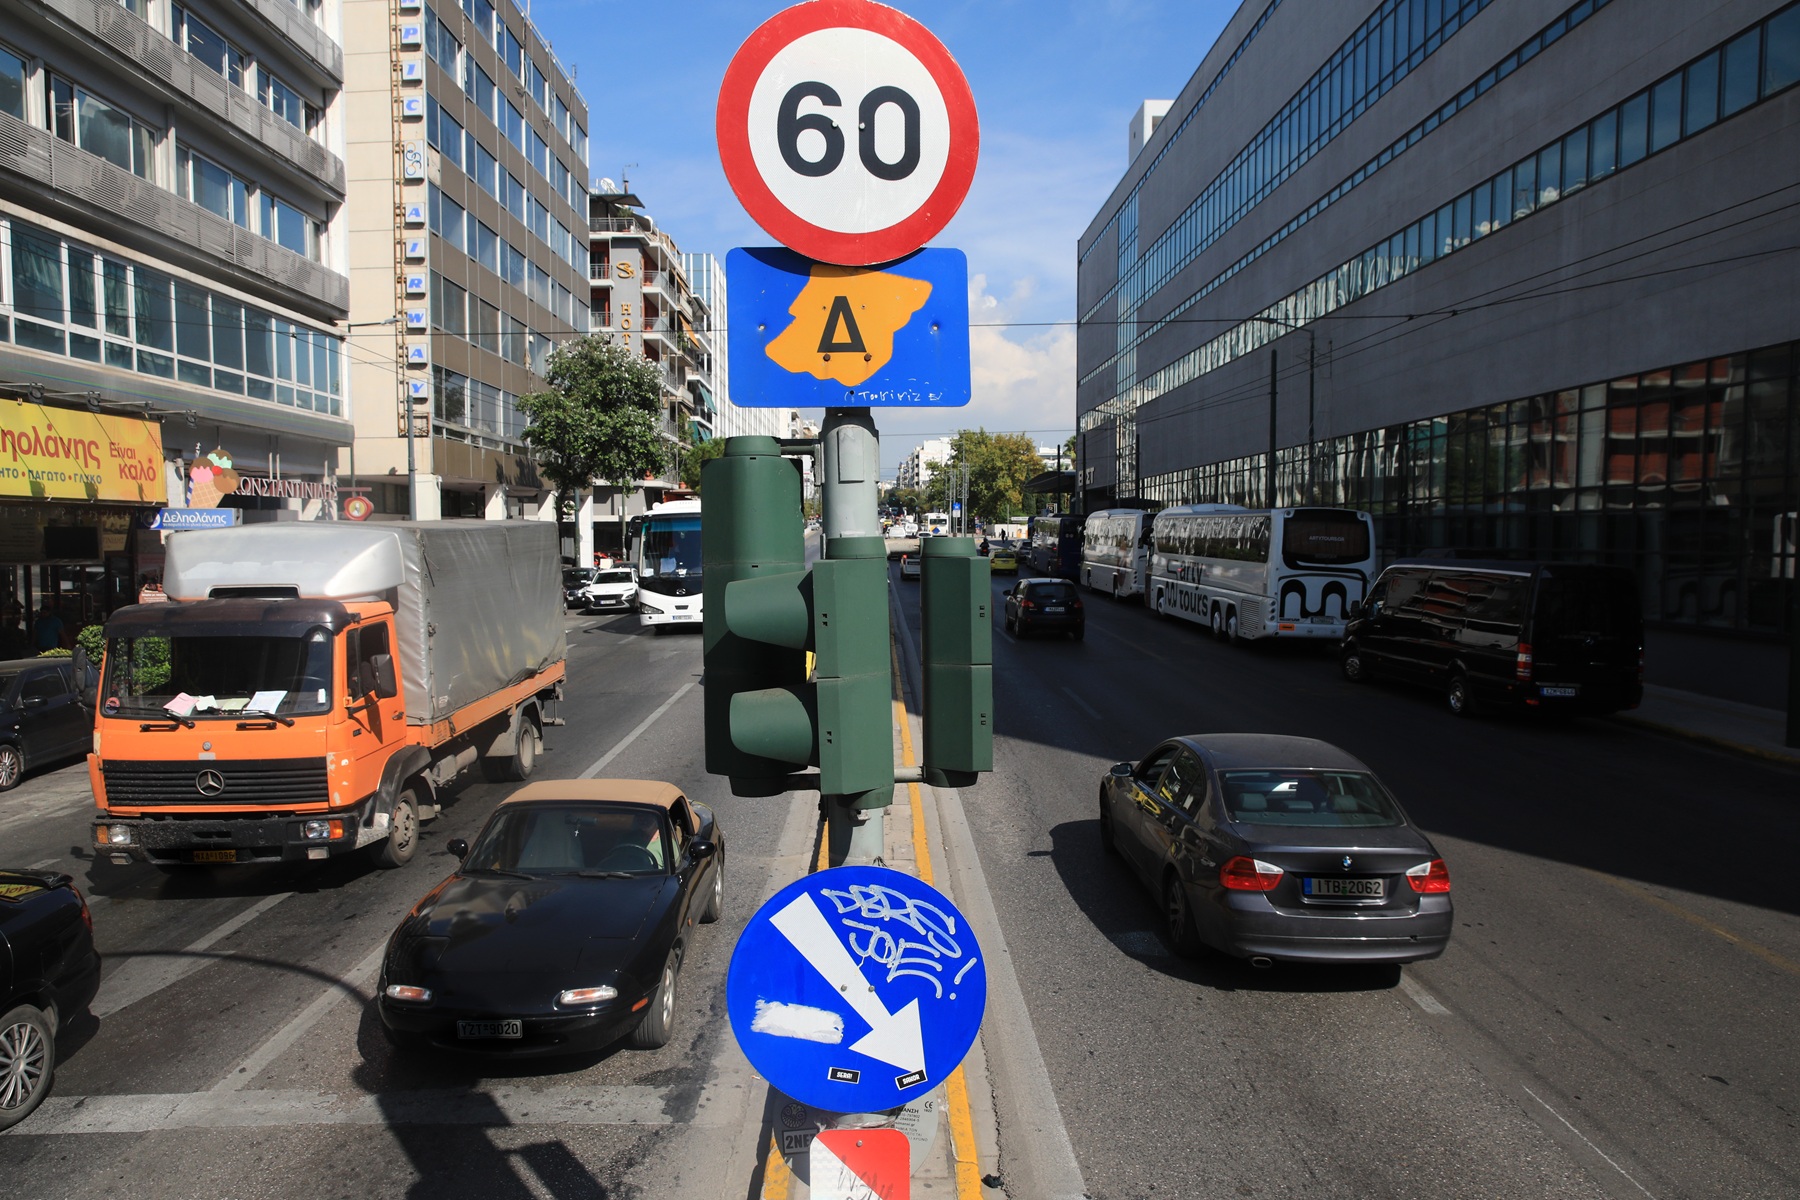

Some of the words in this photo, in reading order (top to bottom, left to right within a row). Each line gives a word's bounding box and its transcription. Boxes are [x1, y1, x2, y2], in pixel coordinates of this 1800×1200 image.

[401, 0, 420, 112] PIC
[777, 81, 921, 181] 60
[620, 303, 632, 353] HOT
[0, 423, 101, 470] ηολάνης
[1179, 589, 1209, 617] tours
